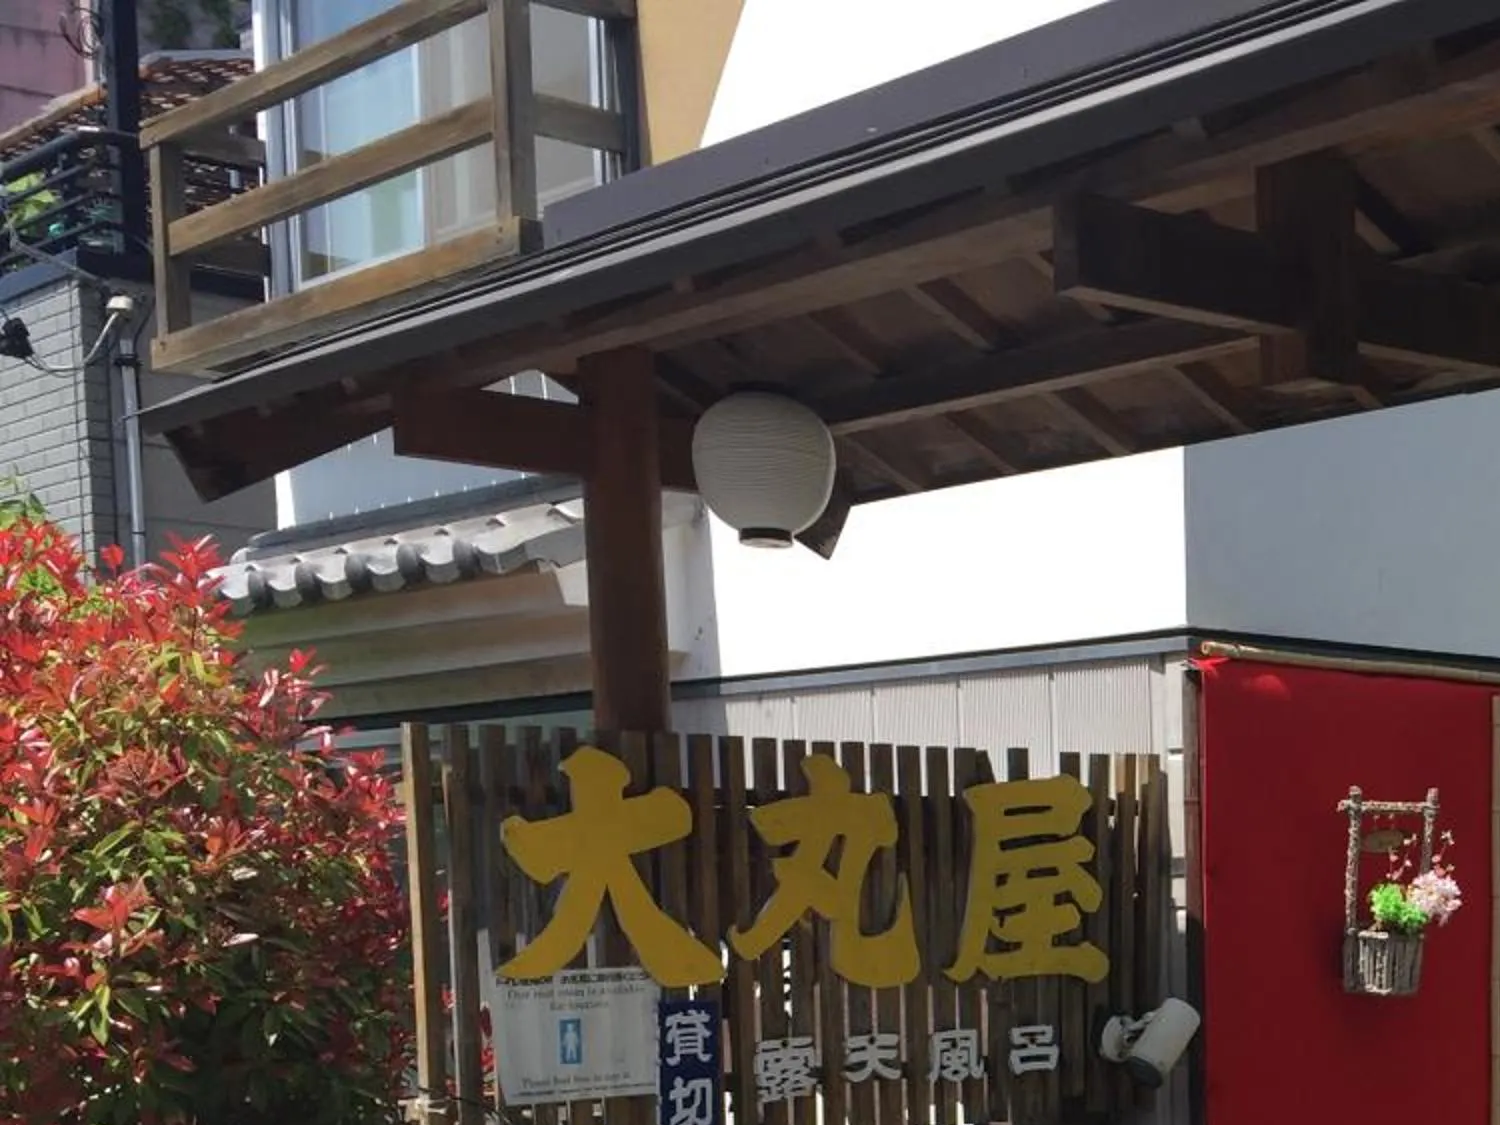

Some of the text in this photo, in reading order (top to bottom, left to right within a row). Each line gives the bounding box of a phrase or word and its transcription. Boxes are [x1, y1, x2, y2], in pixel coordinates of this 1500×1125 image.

[497, 745, 1109, 988] 大丸屋
[754, 1024, 1061, 1103] 露天風呂
